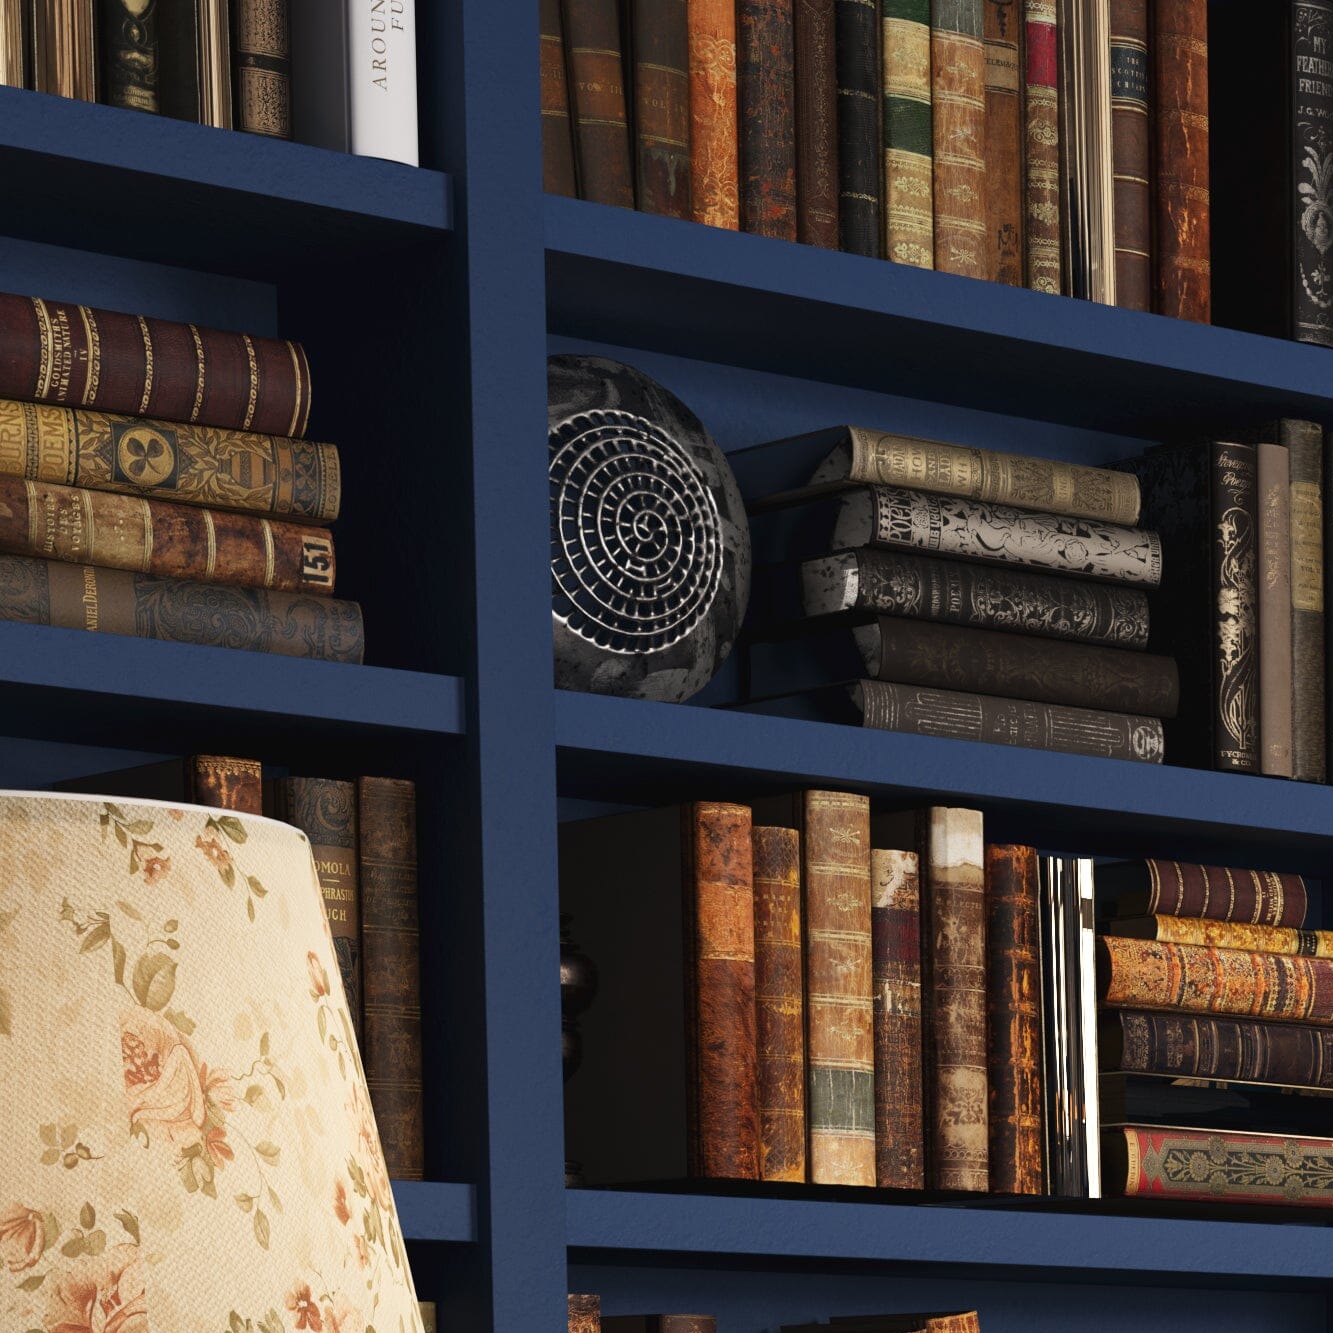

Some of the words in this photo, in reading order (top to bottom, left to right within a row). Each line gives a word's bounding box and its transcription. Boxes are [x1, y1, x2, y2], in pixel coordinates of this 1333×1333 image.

[1313, 36, 1327, 54] MY
[39, 408, 64, 479] POEMS
[303, 542, 331, 583] 151
